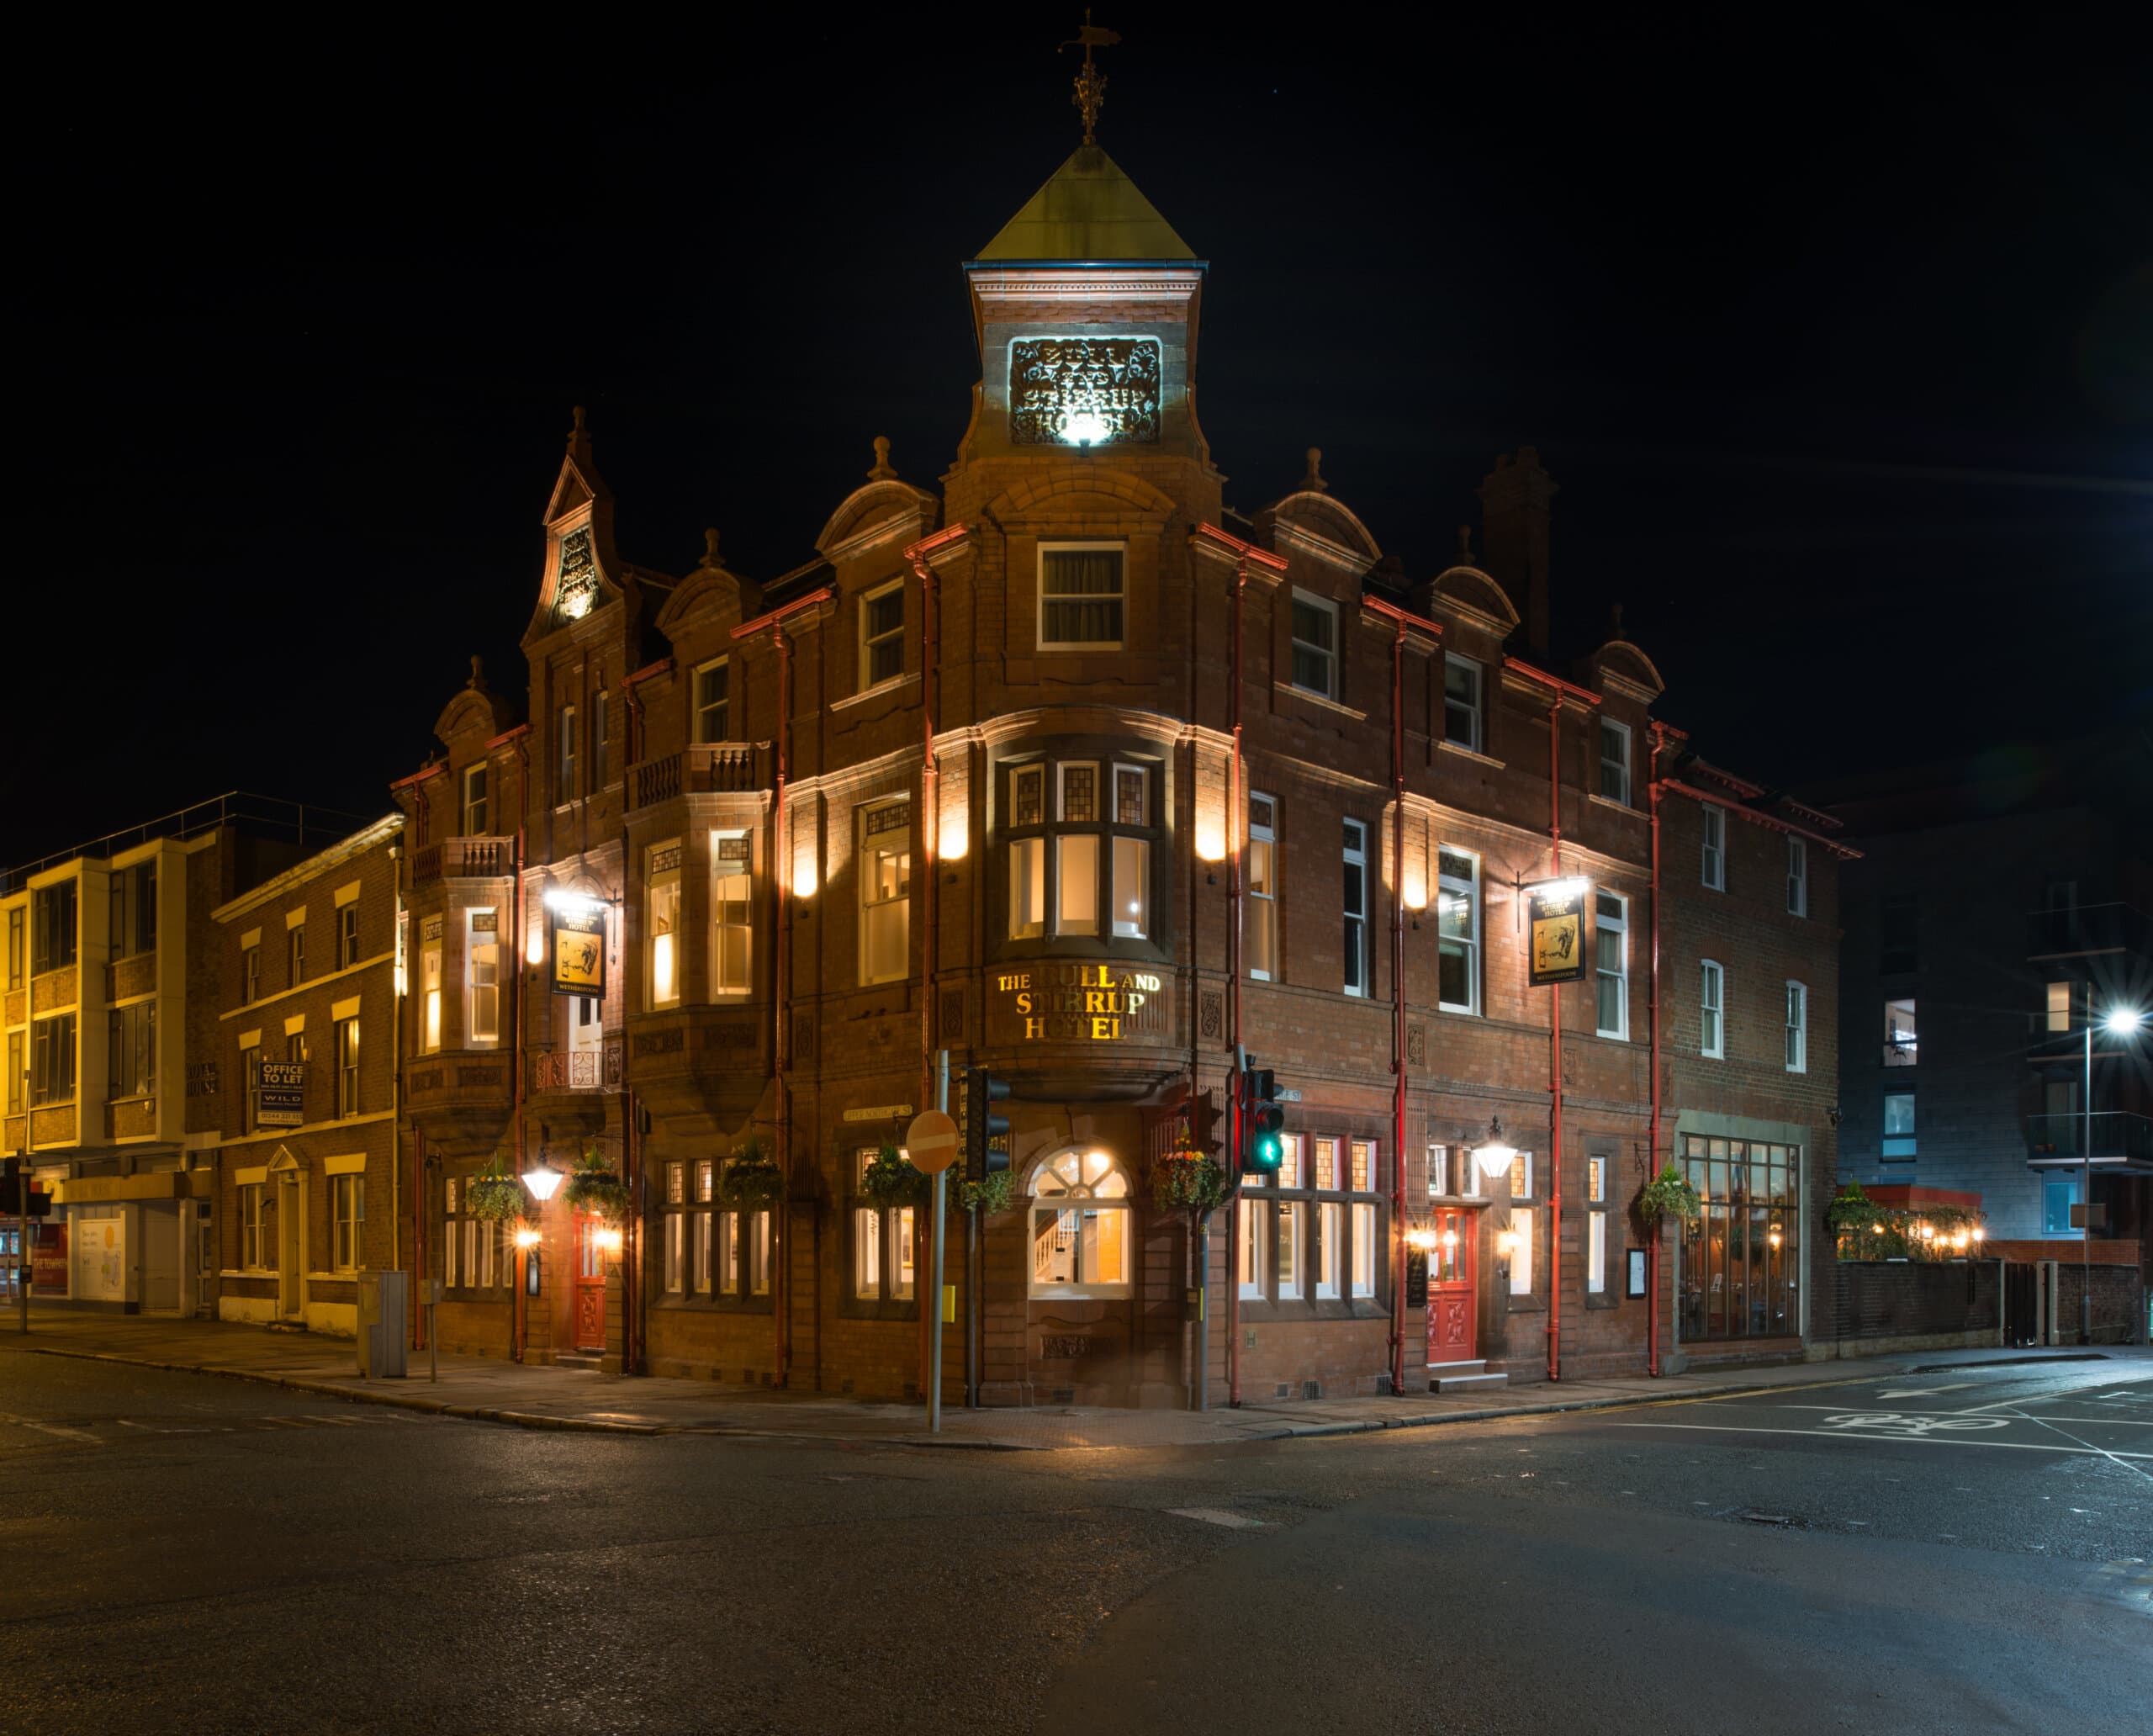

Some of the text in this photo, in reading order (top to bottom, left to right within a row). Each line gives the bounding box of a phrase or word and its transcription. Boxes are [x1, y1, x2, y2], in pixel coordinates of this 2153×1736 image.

[998, 965, 1161, 992] THE BULL AND
[1016, 991, 1145, 1014] STIRRUP
[1024, 1017, 1127, 1040] HOTEL
[263, 1064, 304, 1075] OFFICE
[263, 1074, 304, 1084] TO LET
